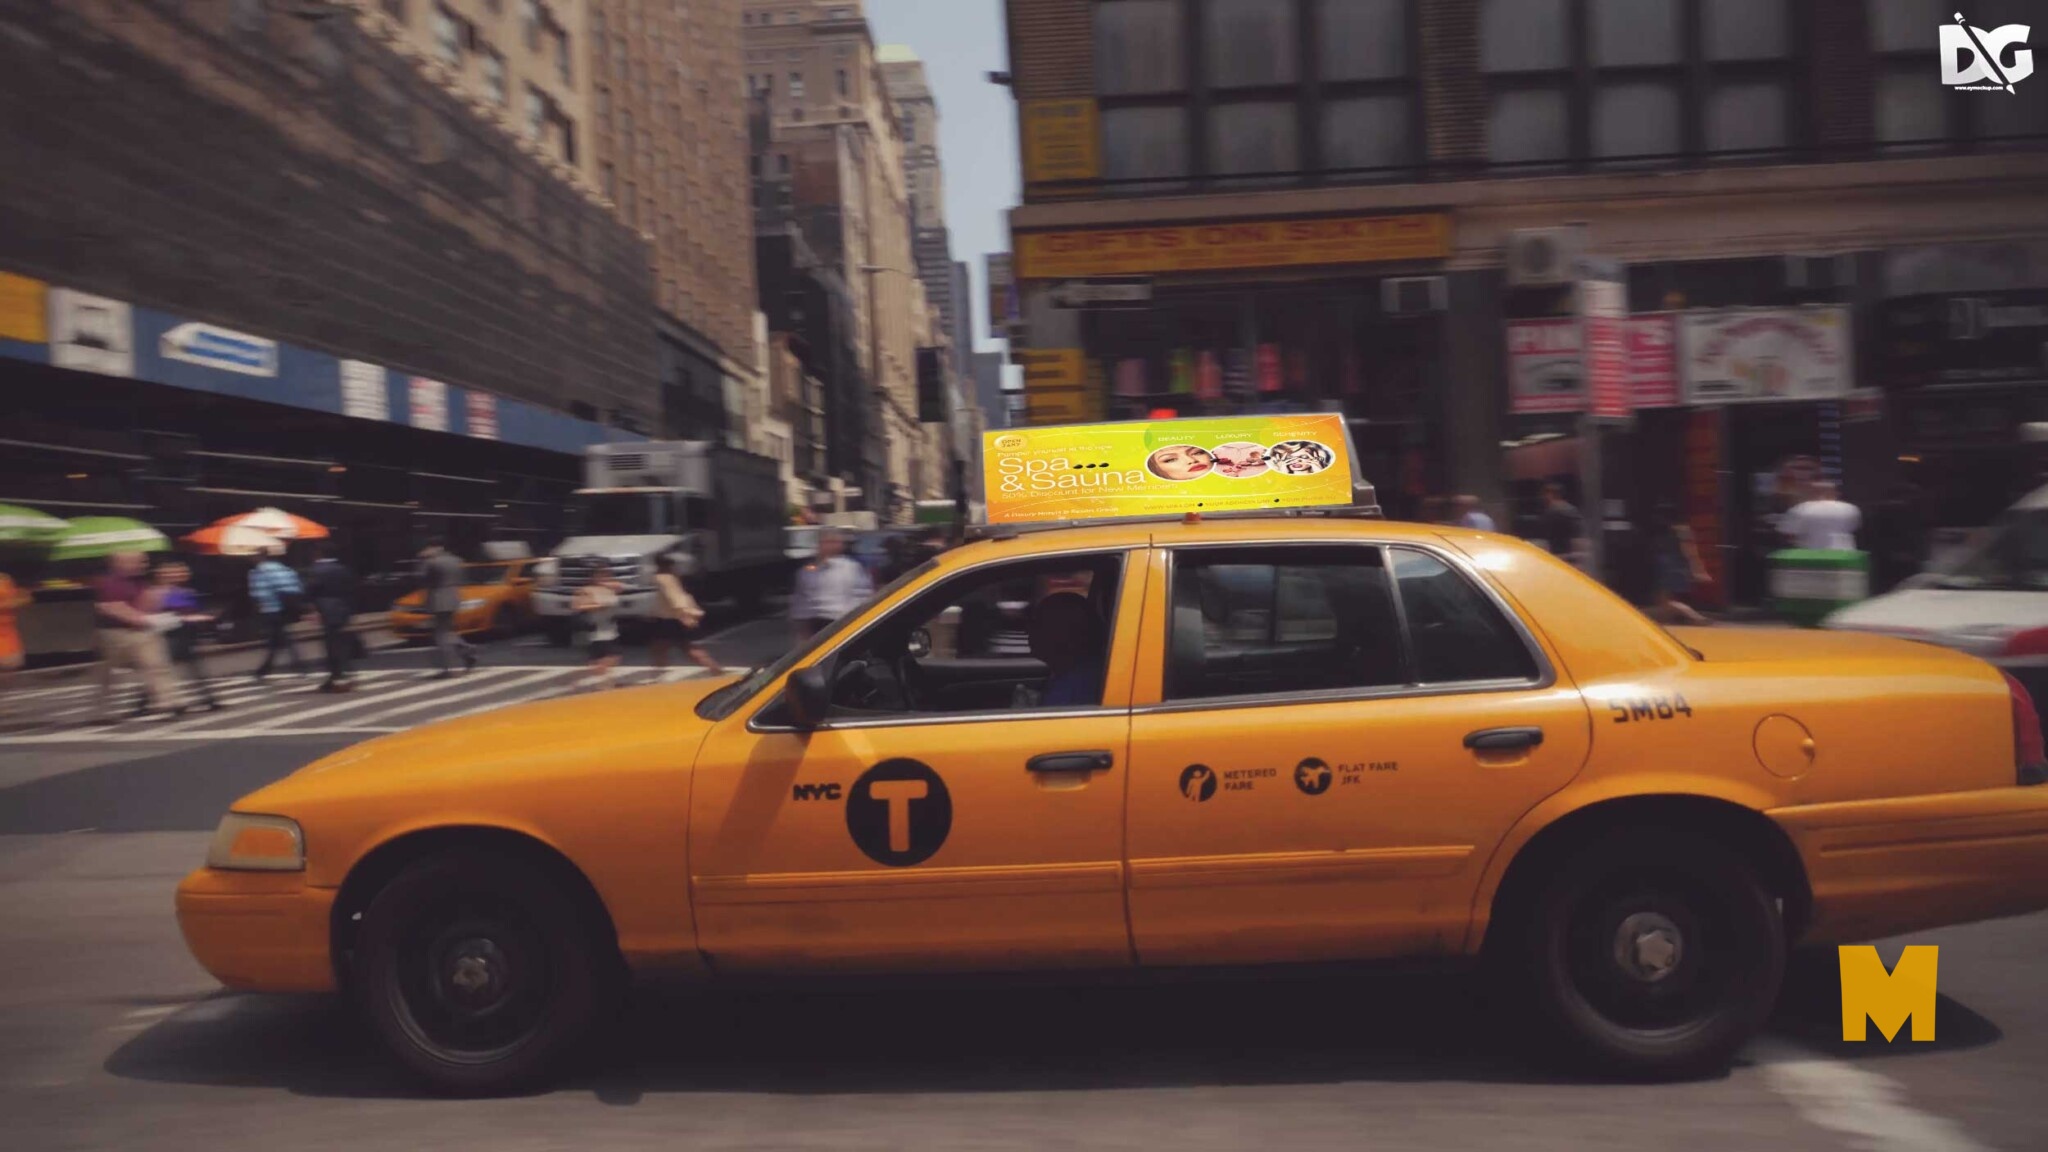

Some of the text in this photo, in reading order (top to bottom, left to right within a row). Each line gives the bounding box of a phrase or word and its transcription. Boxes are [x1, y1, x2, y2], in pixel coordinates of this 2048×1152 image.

[1000, 470, 1147, 492] & Sauna
[1002, 491, 1027, 499] 50%
[1030, 488, 1078, 498] Discount
[1081, 487, 1094, 495] for
[1127, 483, 1179, 492] Members
[1223, 768, 1277, 780] METERED
[1338, 761, 1398, 773] FLAT FARE
[1224, 781, 1253, 791] FARE
[1341, 775, 1360, 785] JFK
[792, 783, 842, 800] NYC
[869, 779, 928, 852] T
